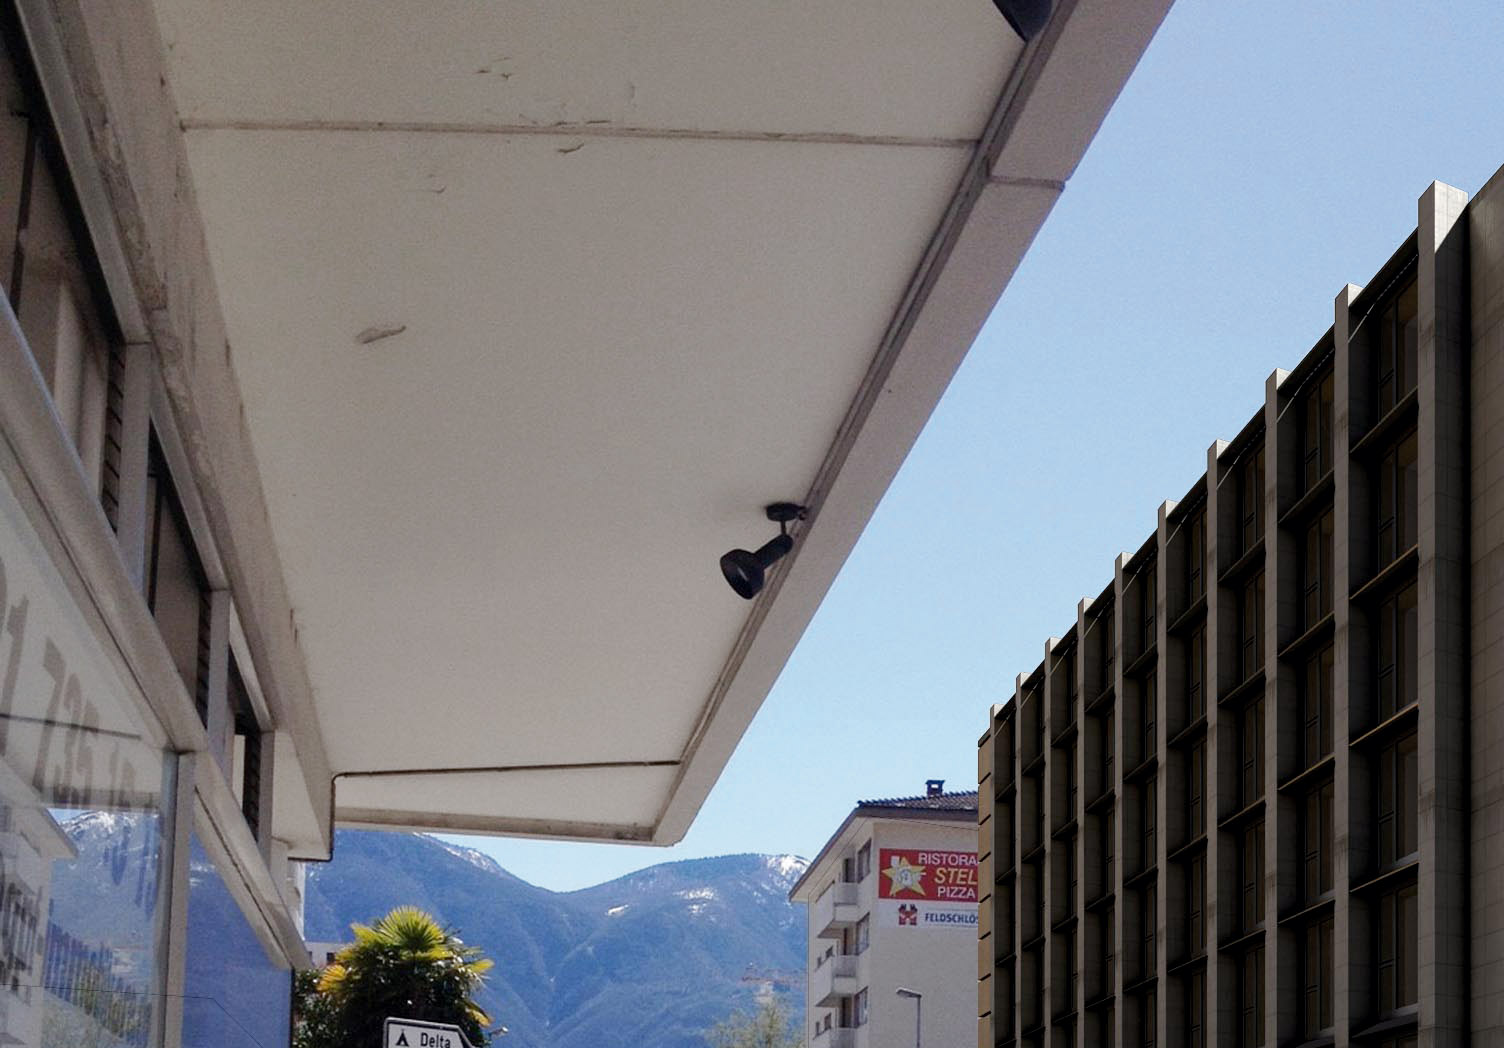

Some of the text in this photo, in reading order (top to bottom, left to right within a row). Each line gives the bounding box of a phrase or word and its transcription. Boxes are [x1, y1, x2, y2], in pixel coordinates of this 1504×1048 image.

[918, 852, 978, 866] RISTORA
[934, 867, 977, 885] STEL
[937, 886, 975, 898] PIZZA
[420, 1032, 451, 1048] Delta
